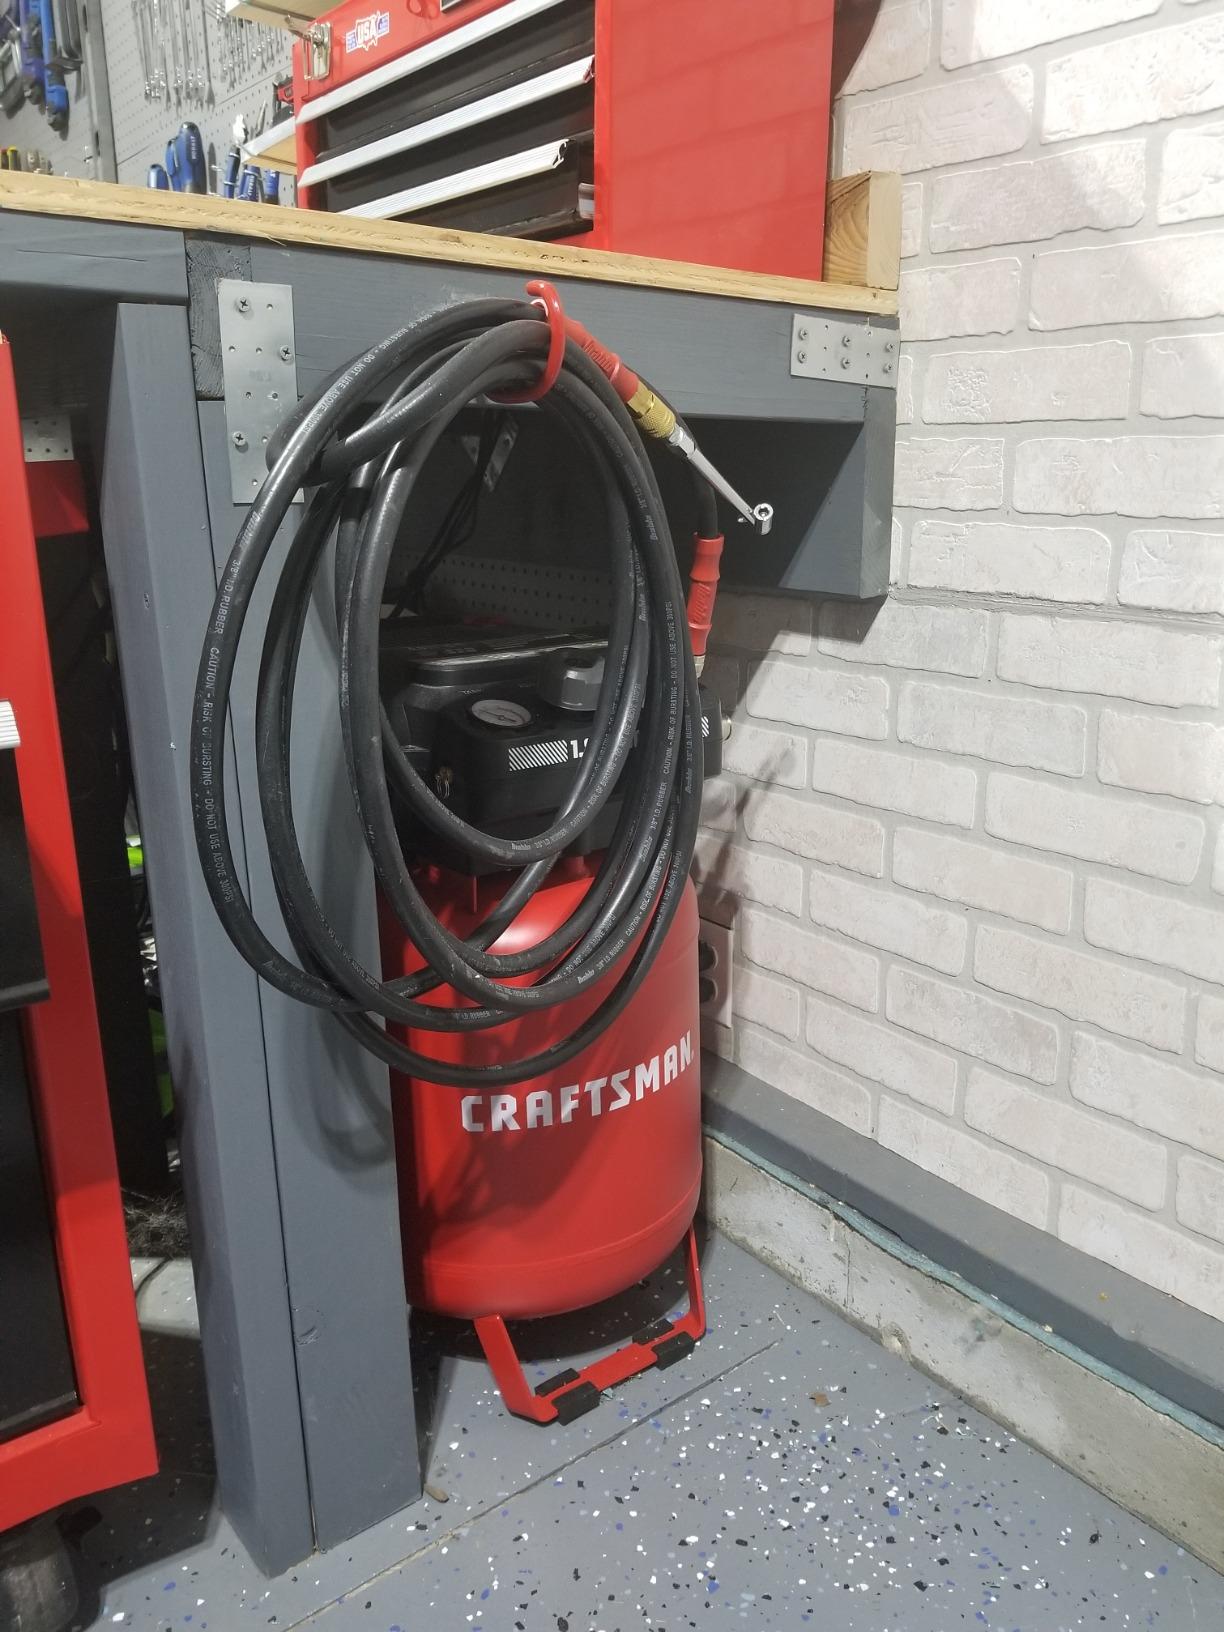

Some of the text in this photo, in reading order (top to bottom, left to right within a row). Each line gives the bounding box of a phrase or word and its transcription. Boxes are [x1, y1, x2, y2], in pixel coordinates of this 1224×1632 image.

[357, 17, 377, 45] USA
[351, 361, 367, 376] NOT
[363, 354, 376, 364] DO
[338, 375, 353, 389] USE
[319, 389, 341, 412] ABOVE
[215, 595, 231, 634] RUBBER
[668, 622, 677, 641] ABOVE
[669, 643, 677, 655] USE
[205, 647, 220, 689] CAUTION
[202, 701, 214, 722] RISK
[670, 686, 678, 715] BURSTING
[667, 726, 676, 740] RISK
[201, 742, 214, 785] BURSTING
[662, 747, 673, 775] CAUTION
[205, 798, 214, 810] DO
[206, 814, 217, 831] NOT
[209, 834, 221, 849] USE
[212, 852, 227, 878] ABOVE
[625, 915, 641, 937] CAUTION
[640, 897, 651, 912] RISK
[461, 1030, 694, 1132] CRAFTSMAN
